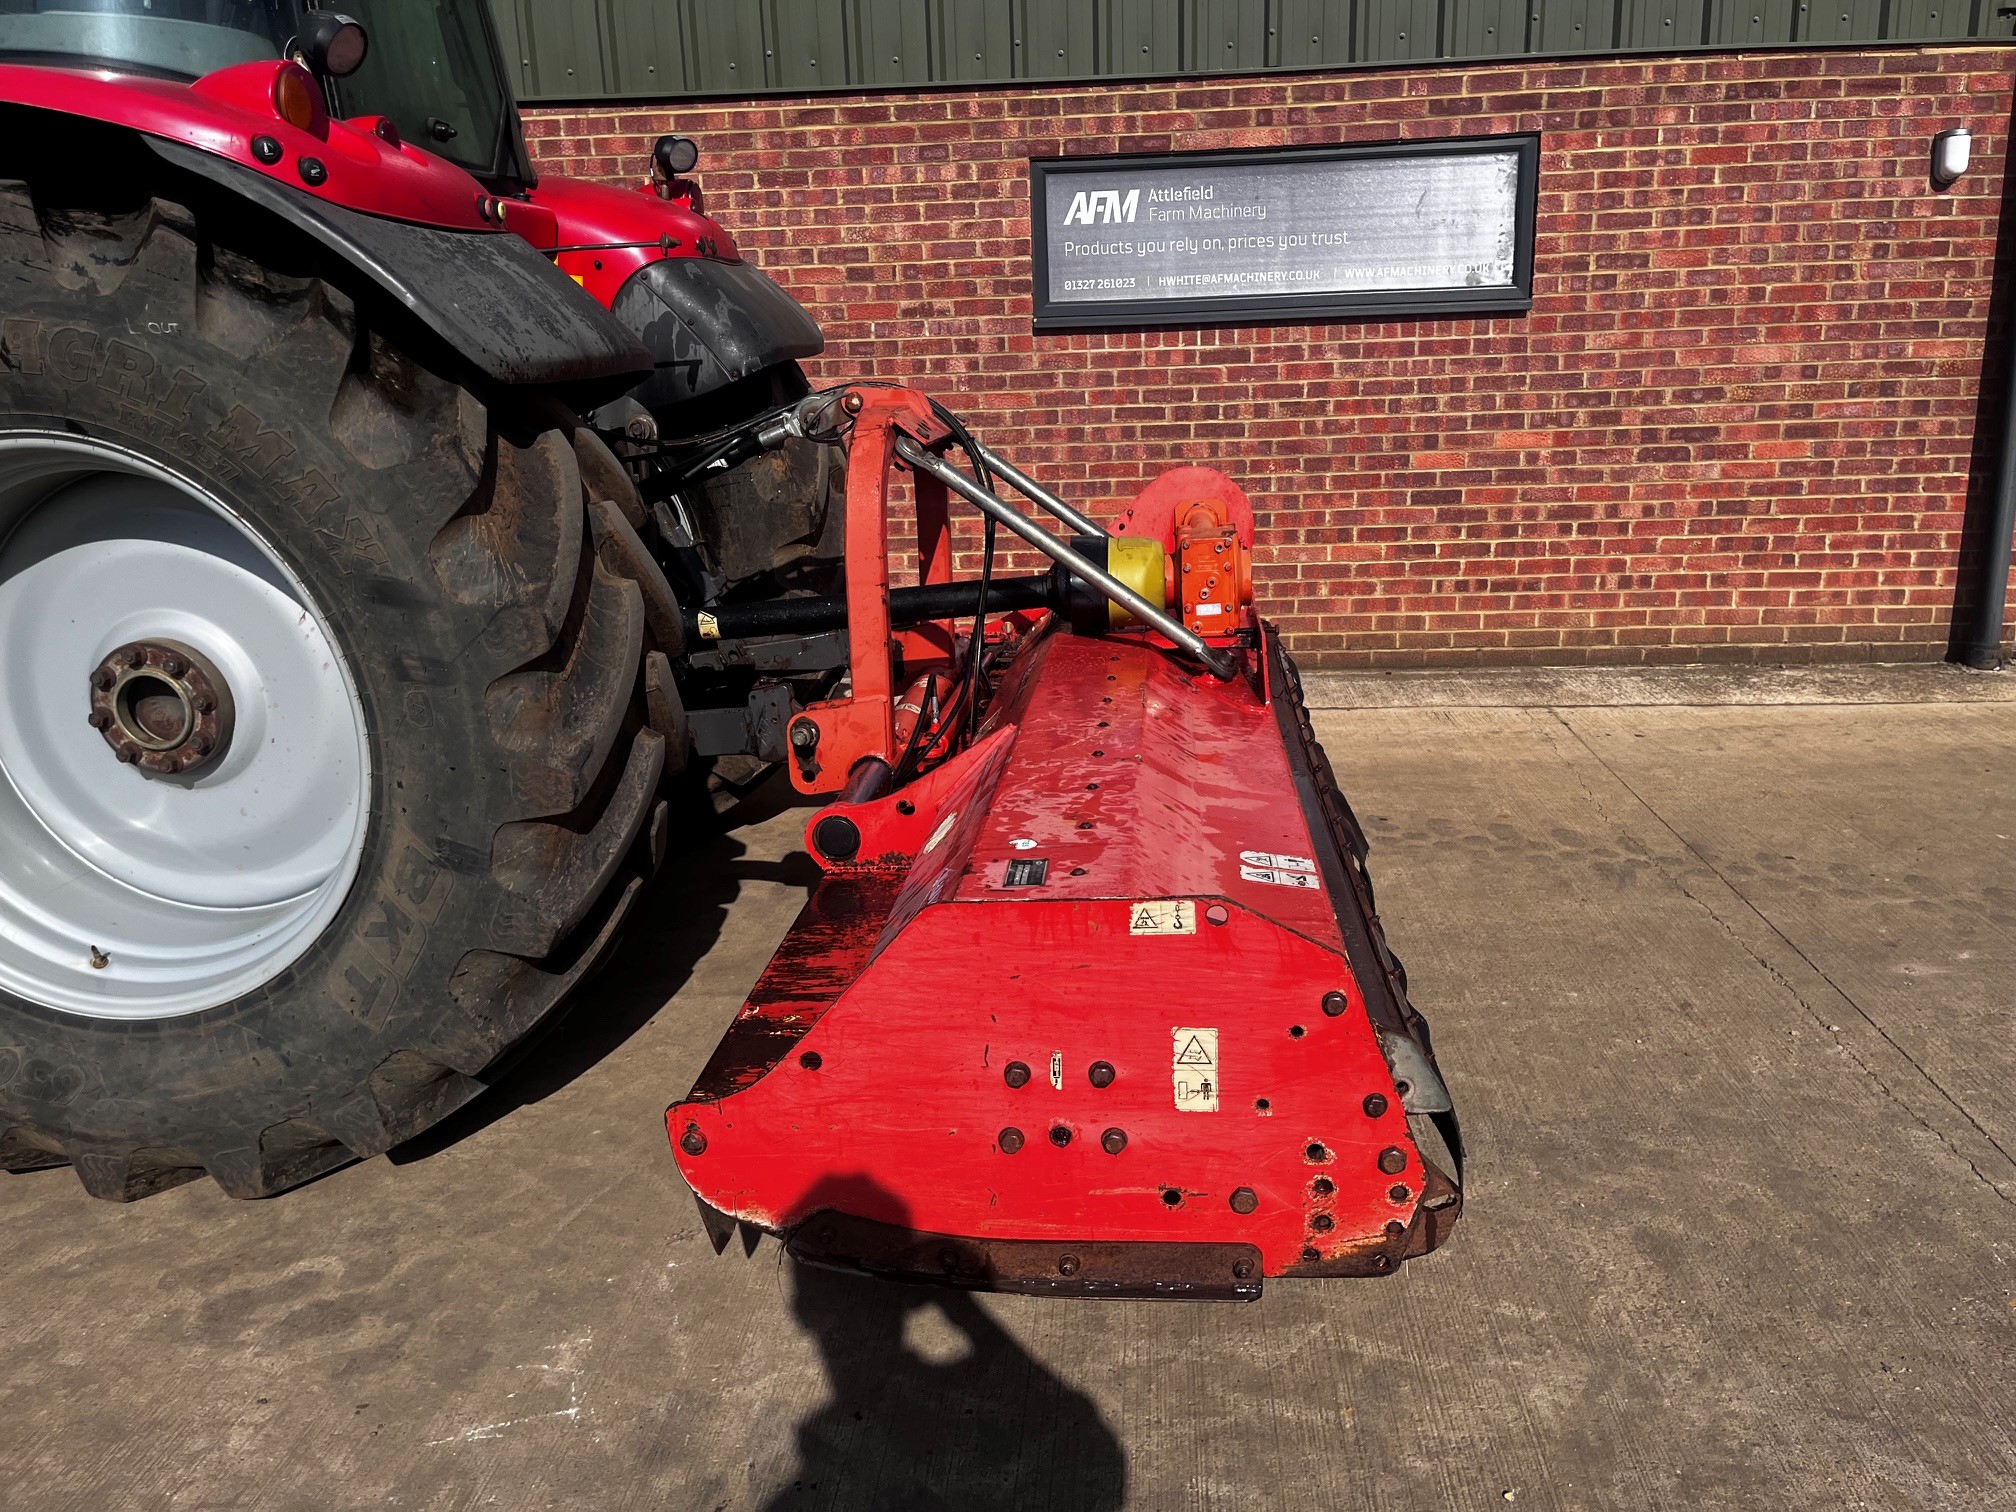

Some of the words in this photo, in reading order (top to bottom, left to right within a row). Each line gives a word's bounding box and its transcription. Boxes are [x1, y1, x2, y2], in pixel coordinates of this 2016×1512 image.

[1148, 185, 1214, 203] Attlefield
[1063, 189, 1141, 226] AFM
[1149, 206, 1185, 222] Farm
[1189, 203, 1267, 220] Machinery
[1065, 241, 1134, 257] Products
[1137, 241, 1166, 257] you
[1169, 236, 1198, 254] rely
[1202, 236, 1225, 252] on,
[1228, 233, 1275, 252] prices
[1278, 234, 1307, 251] you
[1064, 279, 1096, 291] 01327
[1097, 277, 1136, 290] 261023
[1158, 271, 1320, 286] HWHITE@AFMACHINERY.CO.UK
[332, 830, 450, 1027] BKT
